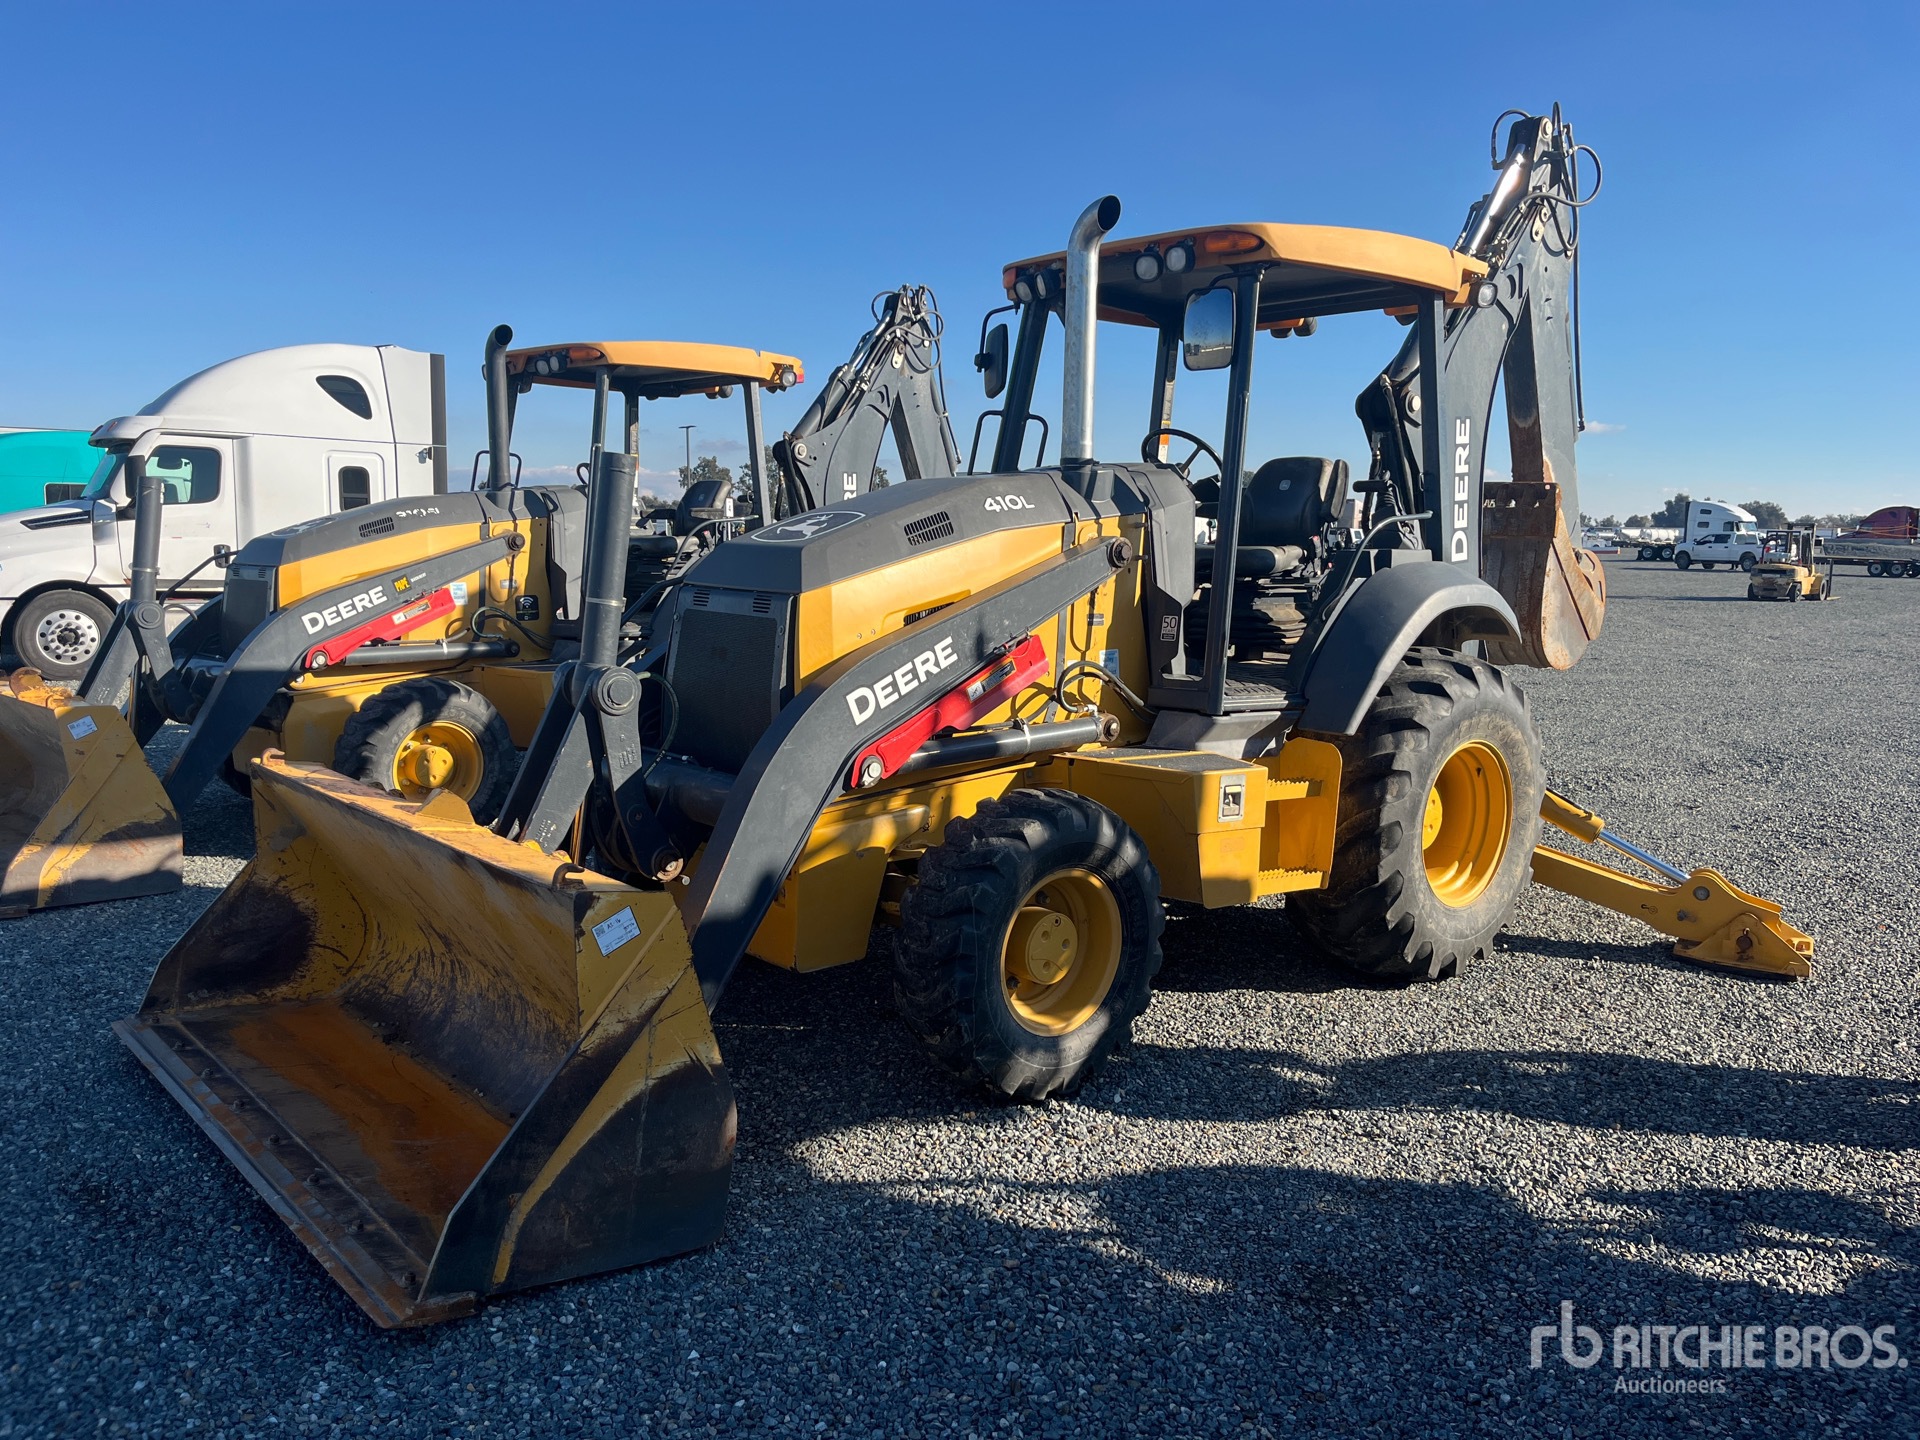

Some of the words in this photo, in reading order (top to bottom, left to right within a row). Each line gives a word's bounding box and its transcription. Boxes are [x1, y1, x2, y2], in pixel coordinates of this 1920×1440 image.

[984, 494, 1036, 513] 410L
[1451, 418, 1471, 562] DEERE
[301, 586, 388, 635] DEERE
[1163, 617, 1177, 628] 50
[845, 636, 959, 726] DEERE
